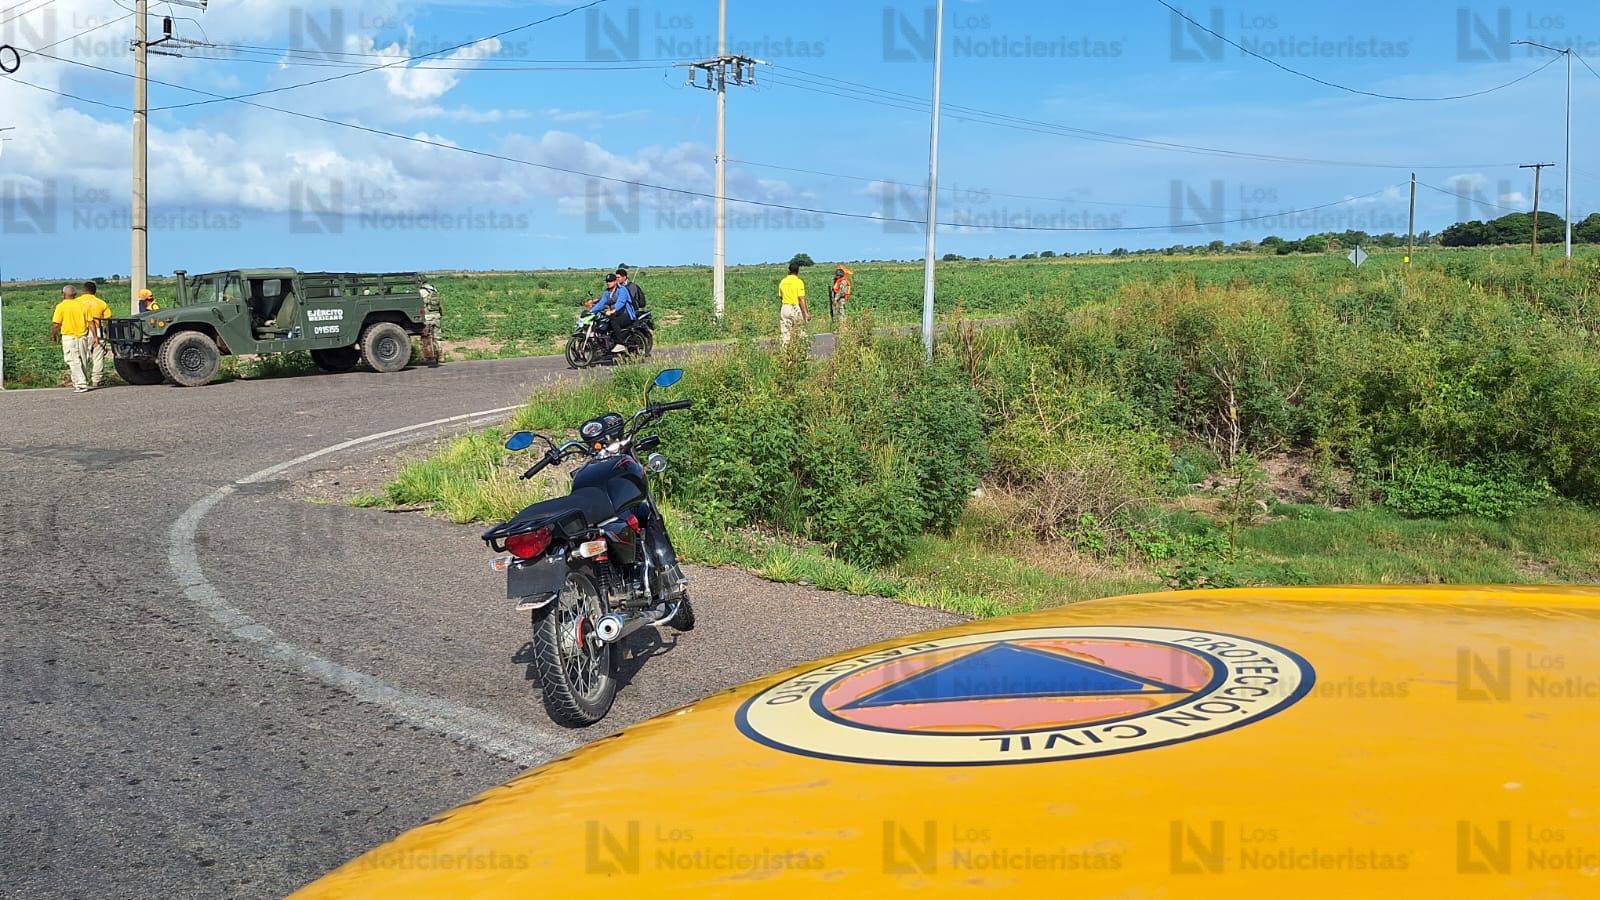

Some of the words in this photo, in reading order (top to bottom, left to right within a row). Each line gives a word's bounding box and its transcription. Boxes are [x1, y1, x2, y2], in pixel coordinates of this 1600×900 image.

[766, 643, 939, 705] NAVOLATO
[1156, 636, 1279, 726] PROTECCIÓN
[979, 724, 1147, 751] CIVIL
